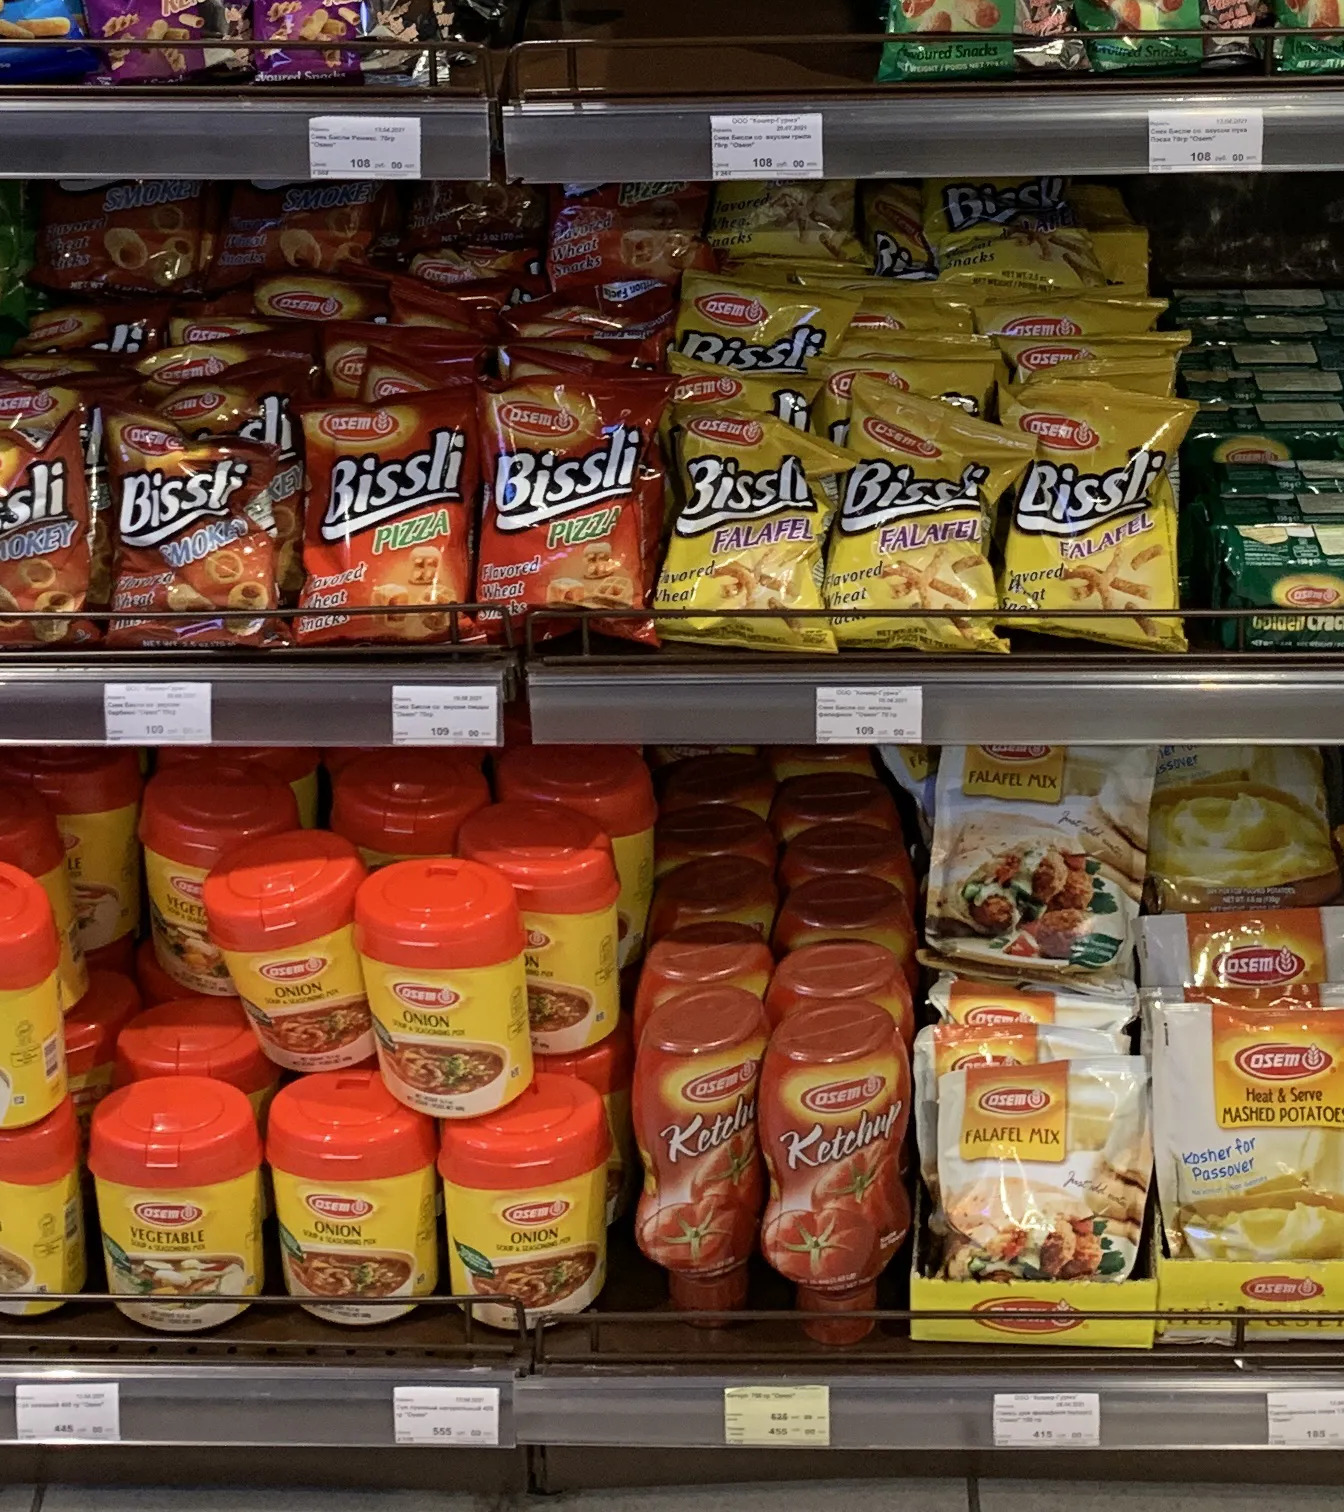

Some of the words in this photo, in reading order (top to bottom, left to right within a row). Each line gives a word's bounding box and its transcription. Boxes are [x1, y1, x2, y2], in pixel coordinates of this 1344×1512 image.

[350, 158, 370, 168] 108
[753, 158, 772, 167] 108
[1191, 152, 1211, 161] 108
[372, 509, 452, 553] PIZZA
[711, 518, 814, 554] FALAFEL
[879, 520, 982, 552] FALAFEL
[482, 557, 540, 581] Flavored
[482, 581, 524, 600] Wheat
[274, 981, 323, 1000] ONION
[402, 1010, 450, 1029] ONION
[1250, 1050, 1298, 1070] OSEM
[1245, 1087, 1273, 1103] Heat
[1277, 1089, 1288, 1103] &
[1291, 1088, 1323, 1103] Serve
[1221, 1104, 1275, 1124] MASHED
[779, 1100, 903, 1170] Ketchup
[965, 1127, 1023, 1146] FALAFEL
[1028, 1127, 1060, 1146] MIX
[1181, 1145, 1232, 1166] Kosher
[1235, 1136, 1257, 1154] for
[1191, 1156, 1255, 1182] Passover
[130, 1226, 205, 1245] VEGETABLE
[433, 1427, 451, 1436] 555
